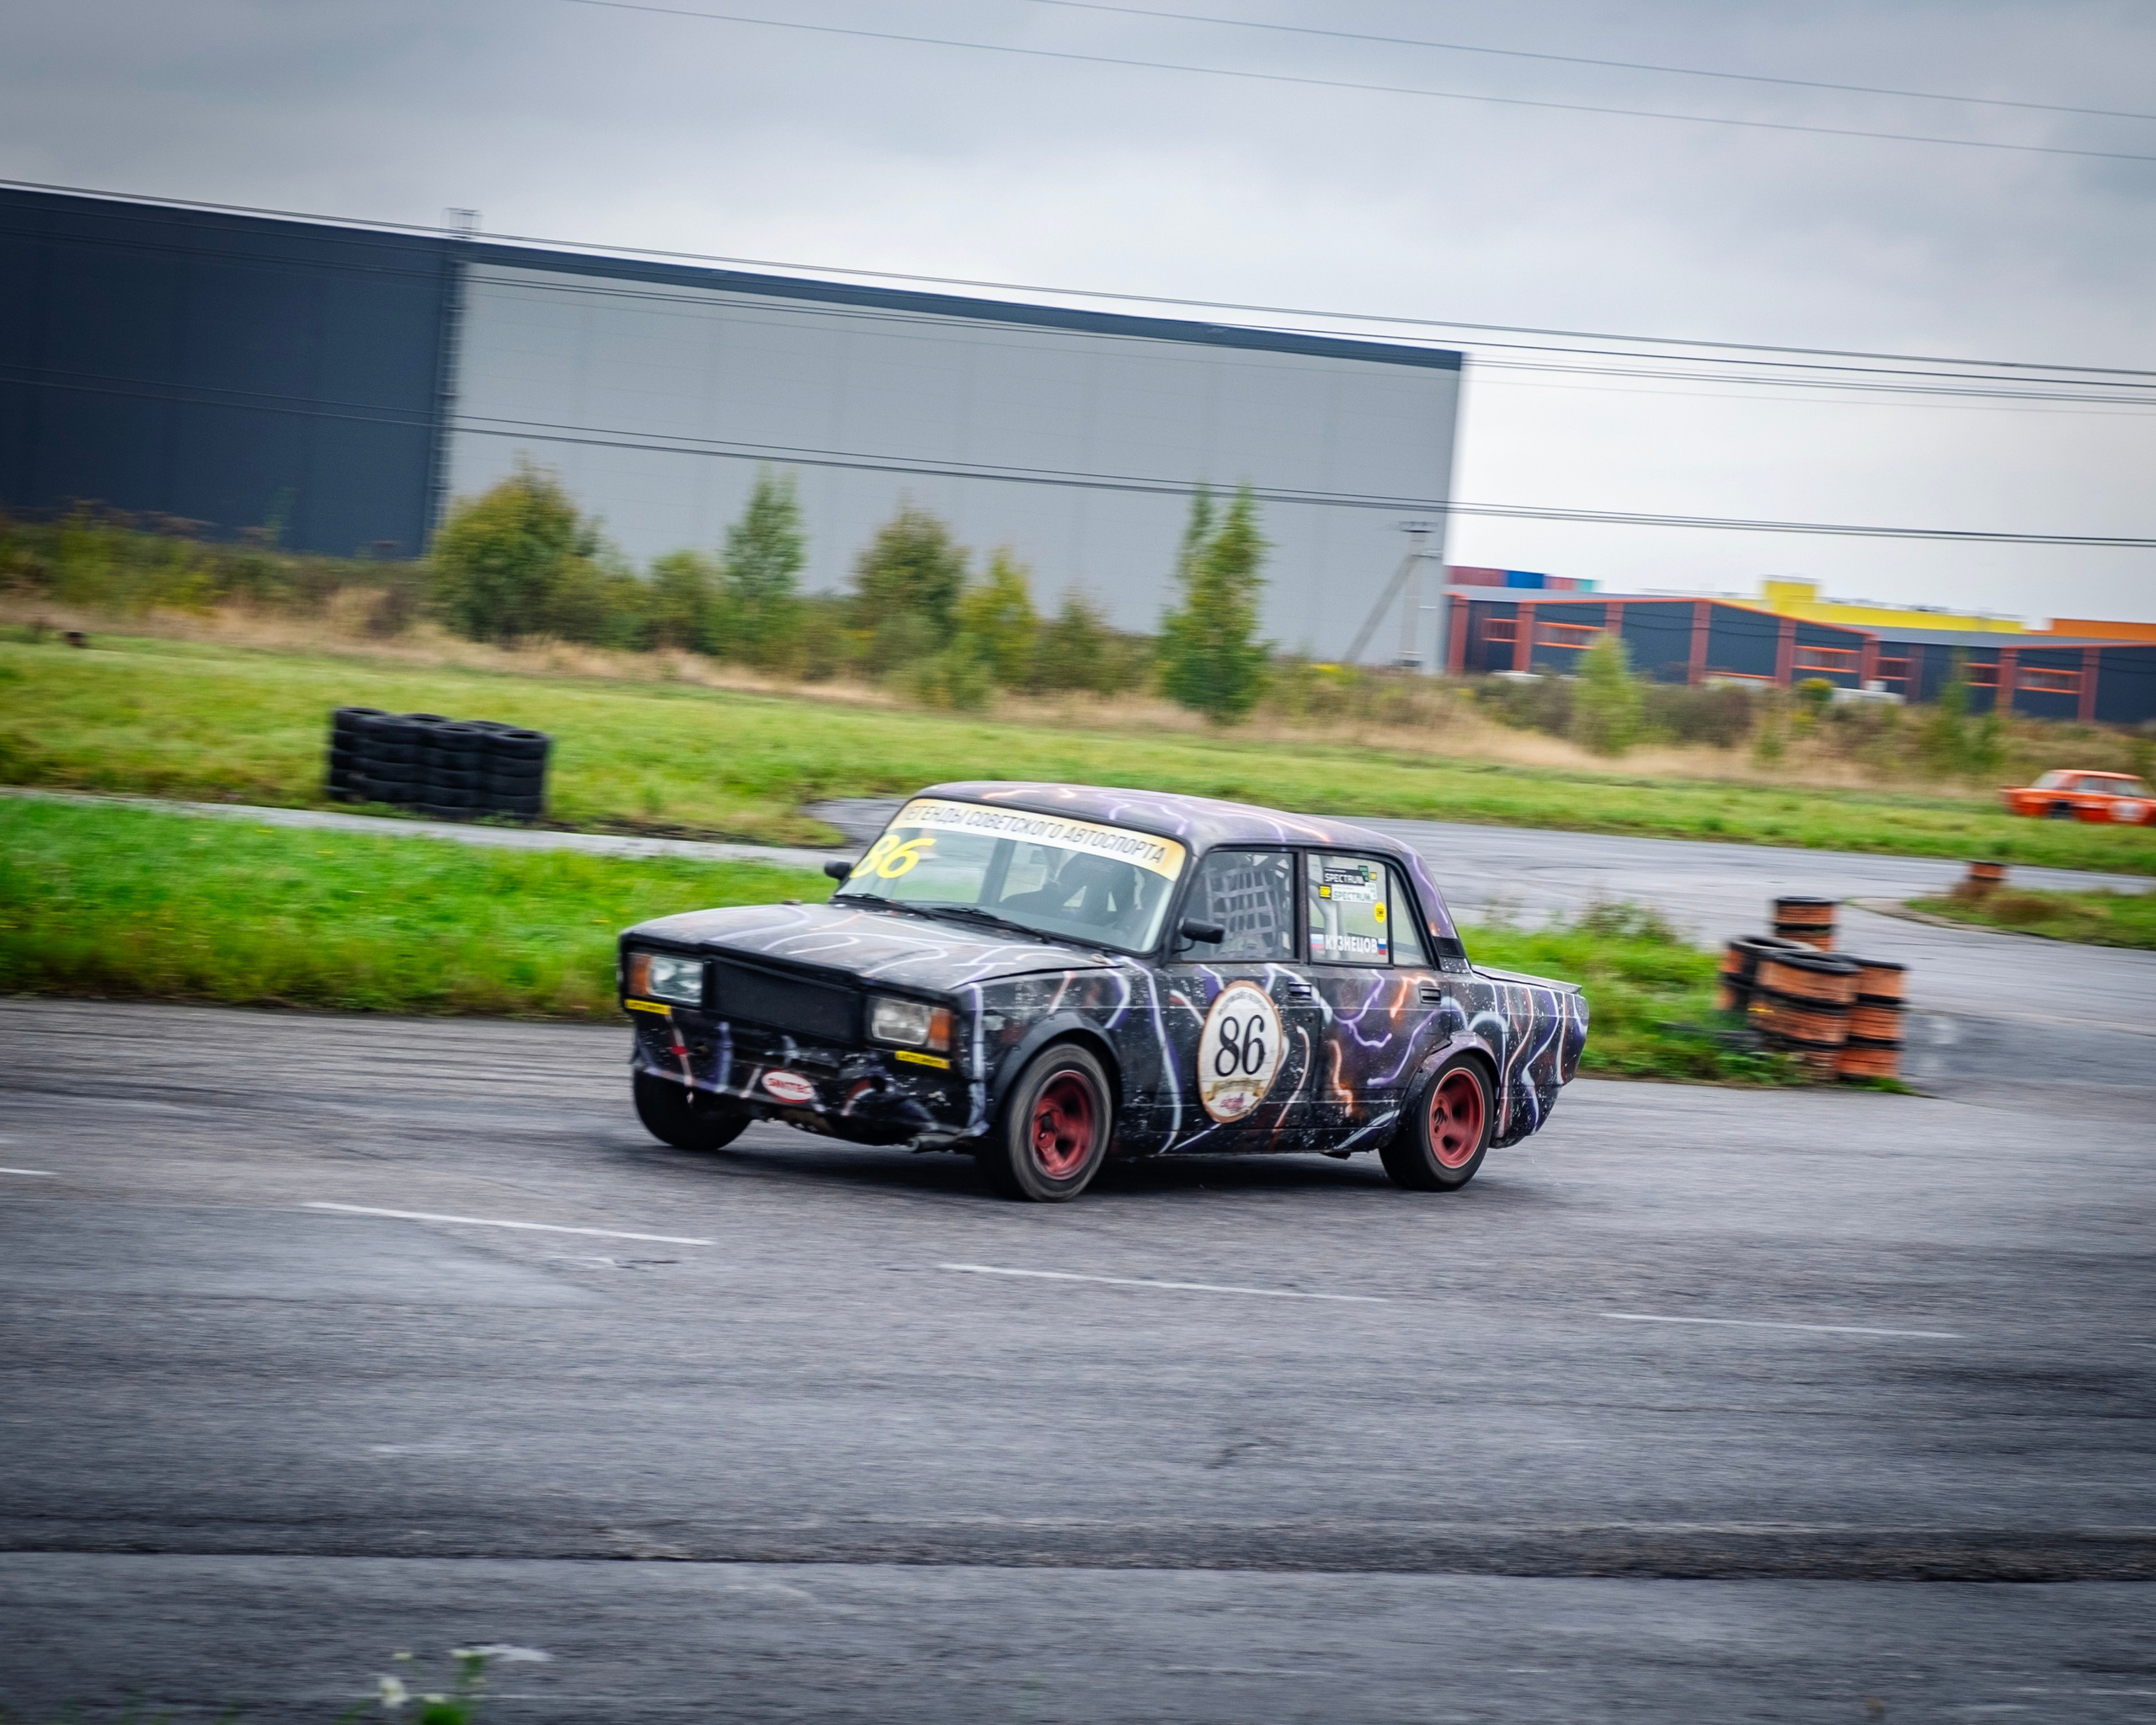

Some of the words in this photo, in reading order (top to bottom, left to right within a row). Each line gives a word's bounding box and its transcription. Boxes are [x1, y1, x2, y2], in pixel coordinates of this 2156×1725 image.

[849, 834, 937, 879] 86
[966, 811, 1065, 839] СОВЕТСКОГО
[1061, 826, 1167, 863] АВТОСПОРТА
[1324, 873, 1365, 884] SPECTRUM
[1325, 934, 1378, 953] КУЗНЕЦОВ
[1214, 1014, 1266, 1077] 86
